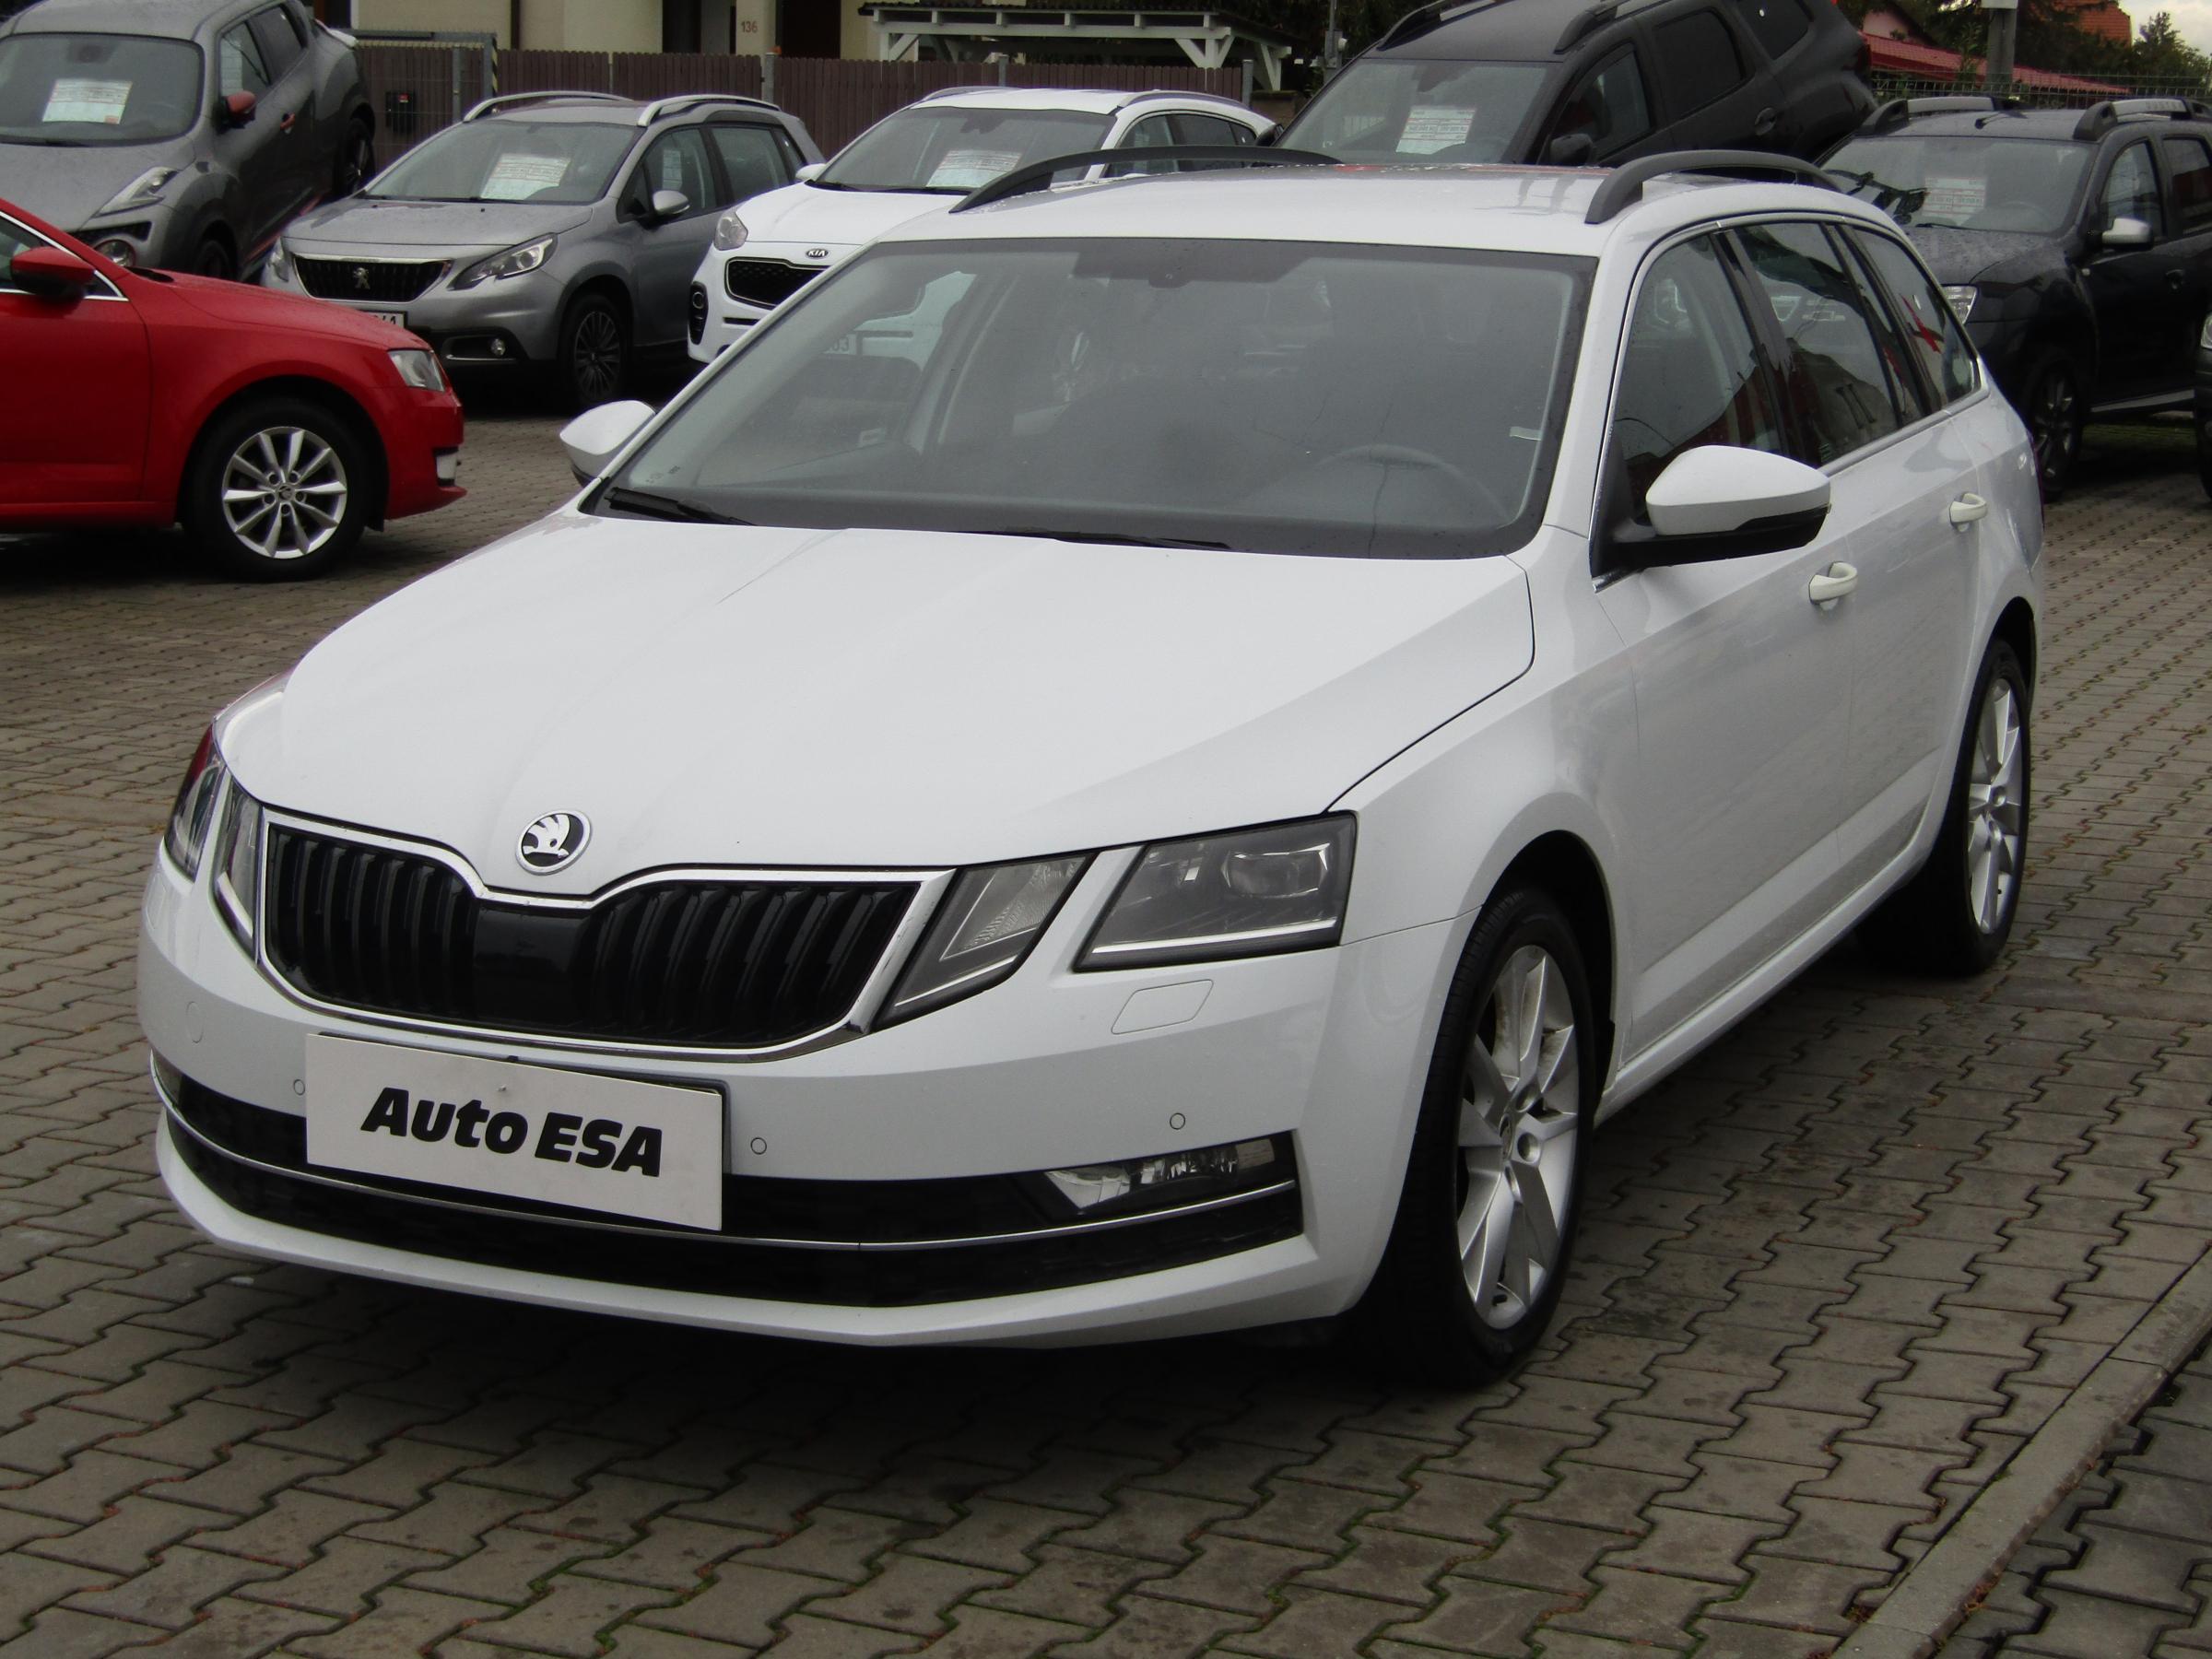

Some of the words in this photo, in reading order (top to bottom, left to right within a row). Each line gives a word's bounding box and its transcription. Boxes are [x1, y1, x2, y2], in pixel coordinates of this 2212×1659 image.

[741, 20, 758, 33] 136
[360, 1087, 528, 1154] Auto
[535, 1112, 663, 1177] ESA
